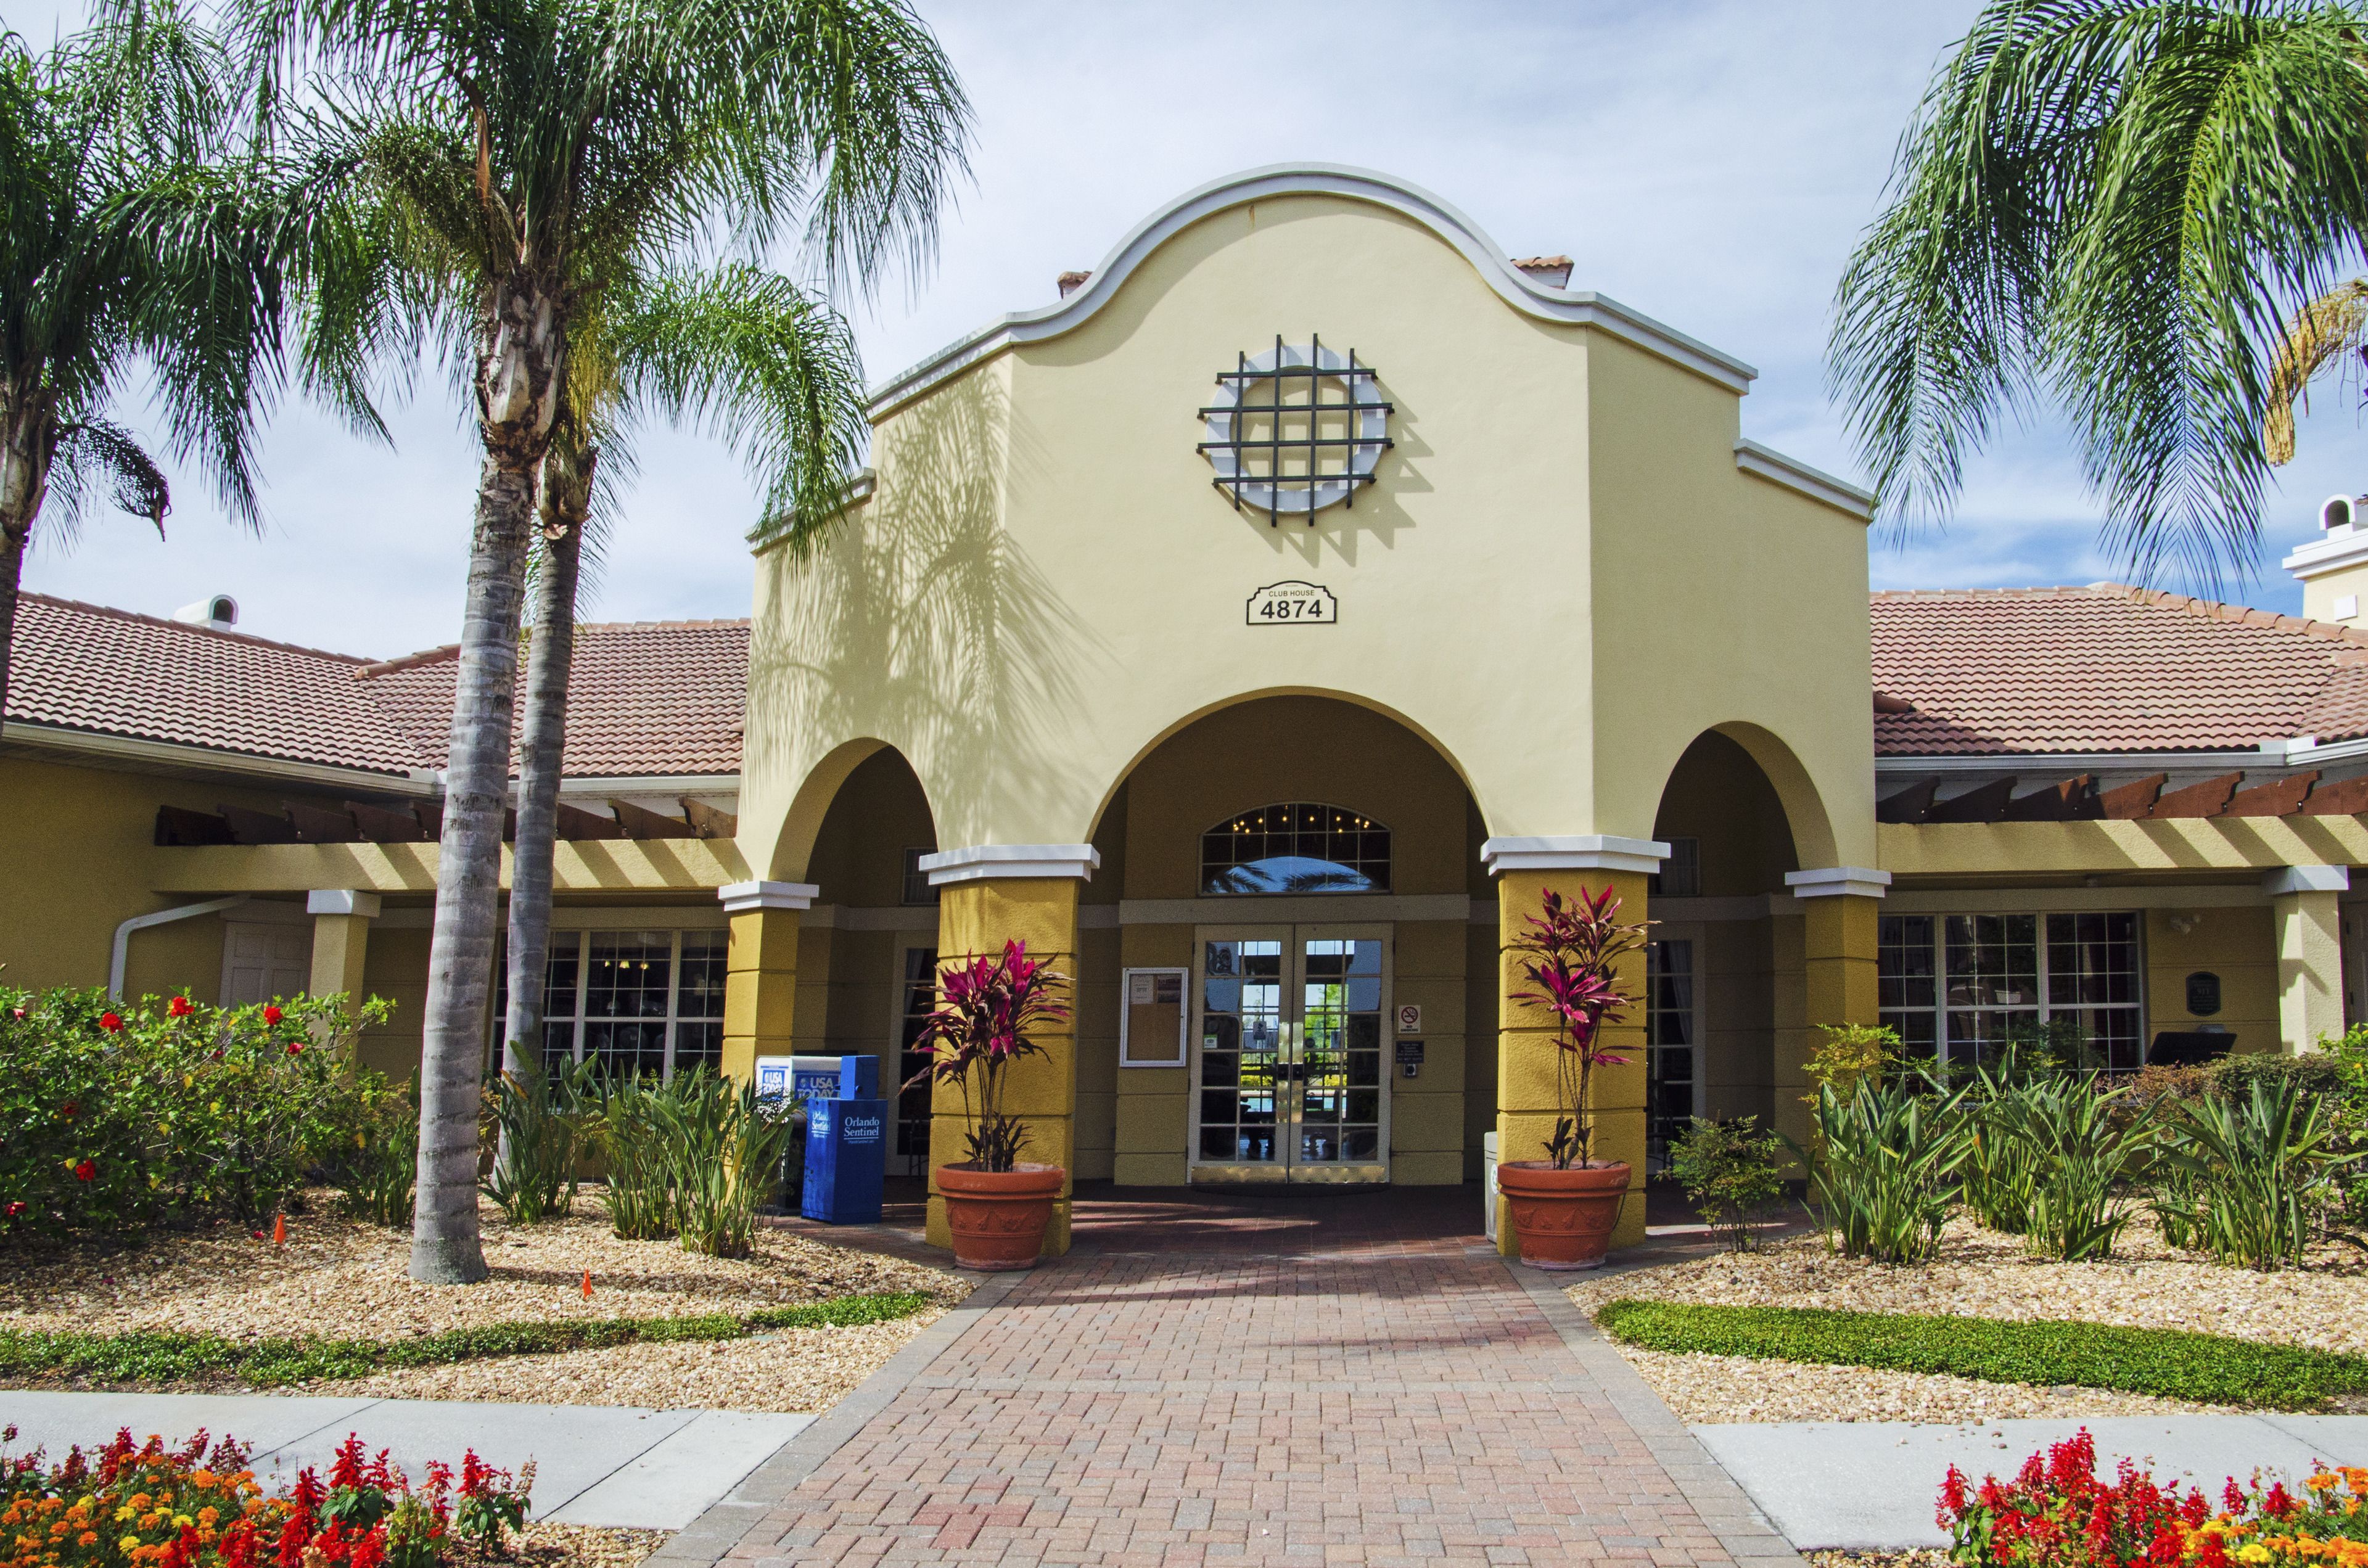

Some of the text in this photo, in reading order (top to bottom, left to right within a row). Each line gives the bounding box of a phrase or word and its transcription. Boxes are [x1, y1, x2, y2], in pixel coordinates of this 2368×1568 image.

[1260, 599, 1323, 618] 4874
[770, 1072, 783, 1083] USA
[810, 1077, 833, 1089] USA
[797, 1088, 834, 1099] TODAY
[845, 1117, 879, 1127] Orlando
[844, 1127, 879, 1137] Sentinel
